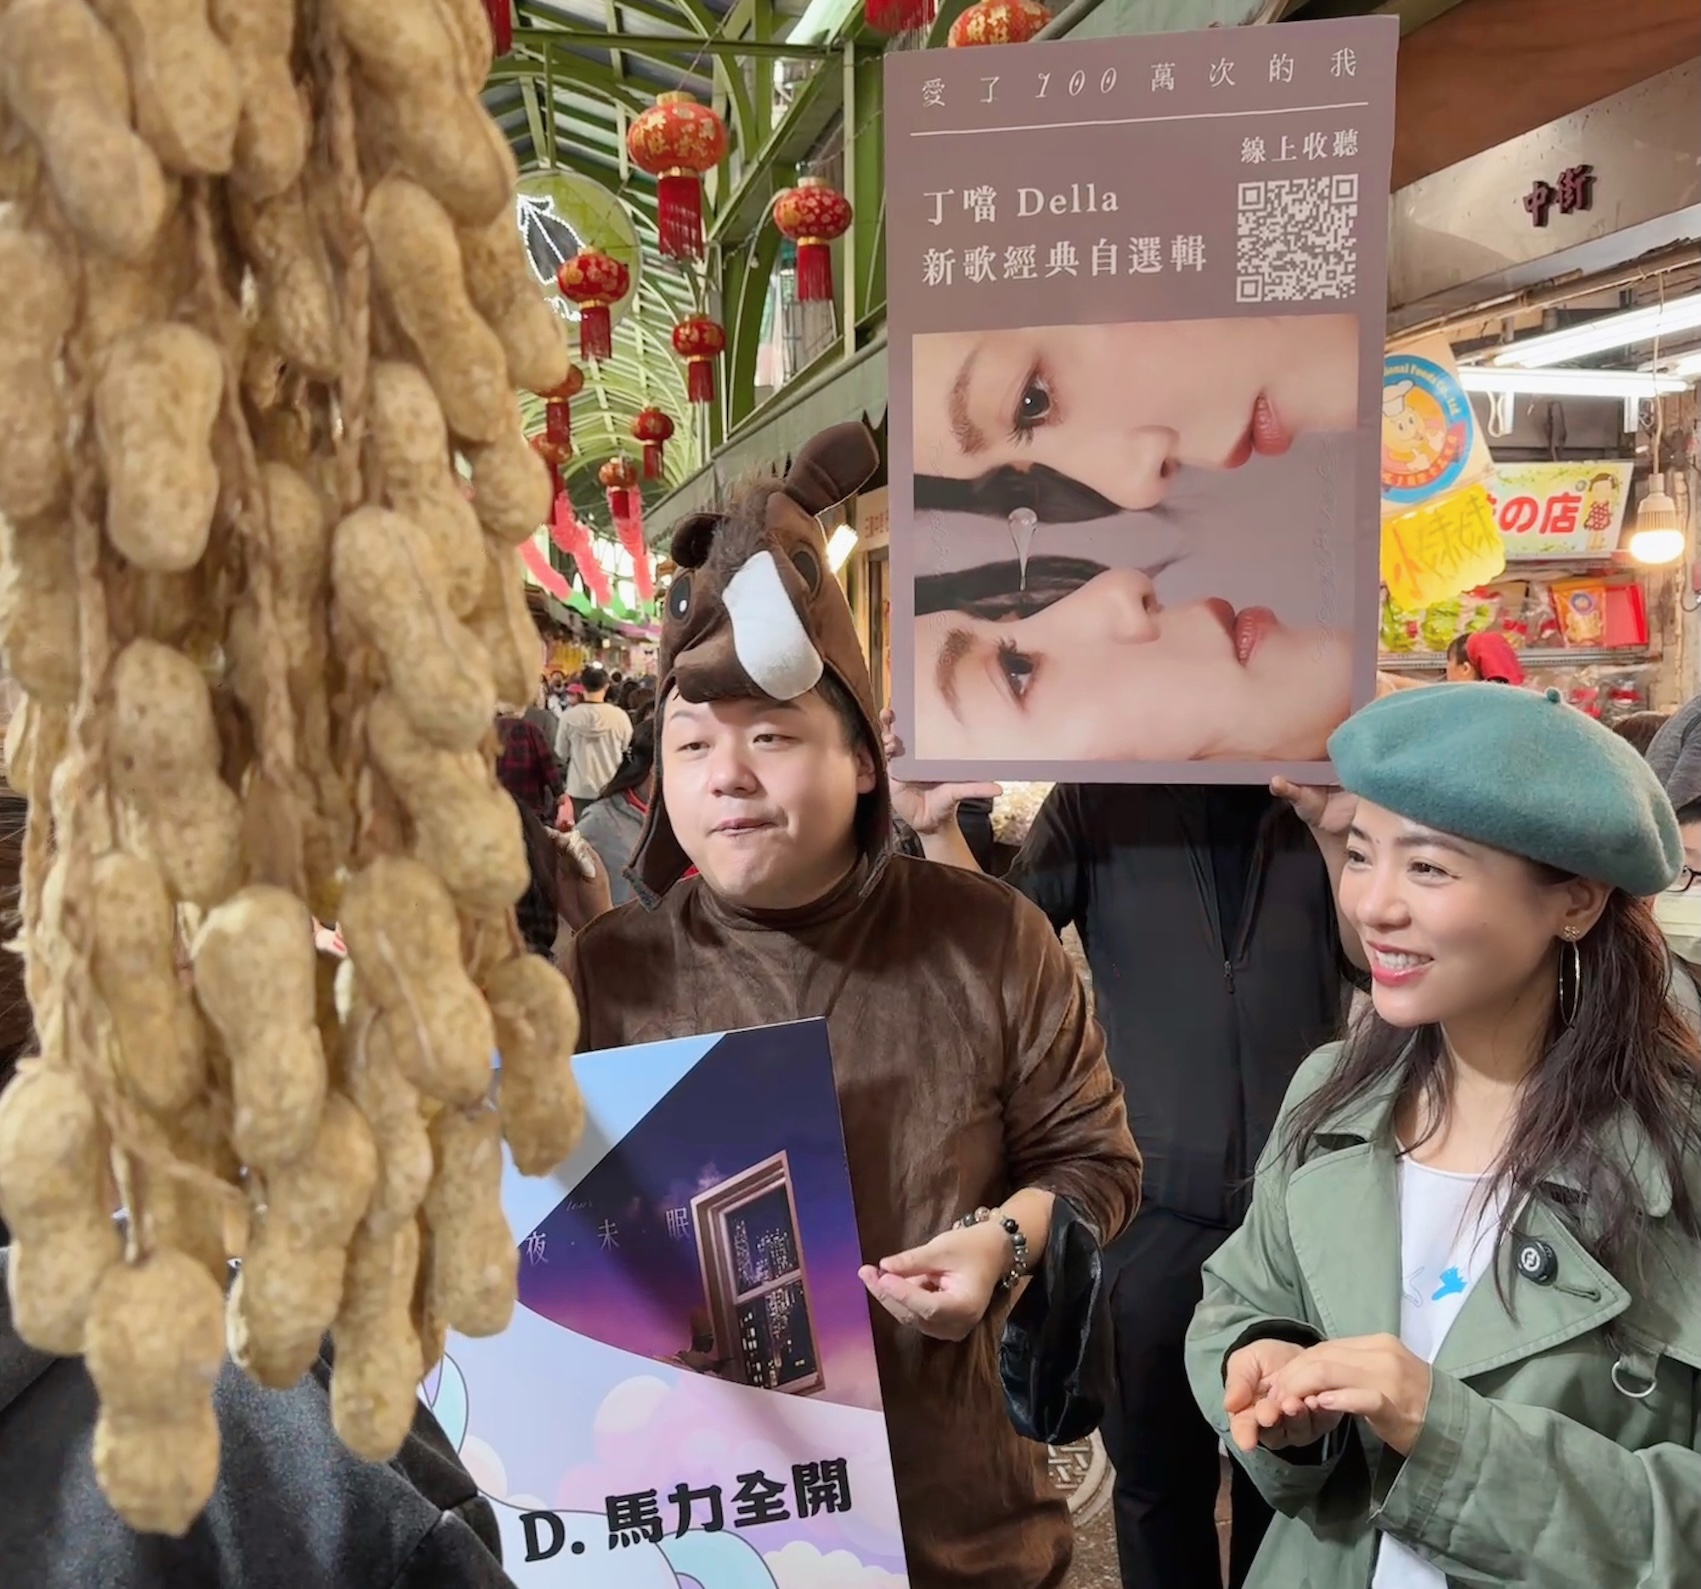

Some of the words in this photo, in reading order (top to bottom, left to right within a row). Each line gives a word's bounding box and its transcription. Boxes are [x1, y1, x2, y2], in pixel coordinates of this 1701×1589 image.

[1241, 129, 1359, 165] 線上收聽
[923, 186, 997, 226] 丁噹
[1017, 183, 1119, 217] Della
[1523, 164, 1596, 227] 中街
[922, 234, 1207, 287] 新歌經典自選輯
[519, 1510, 585, 1562] D.
[605, 1457, 851, 1550] 馬力全開
